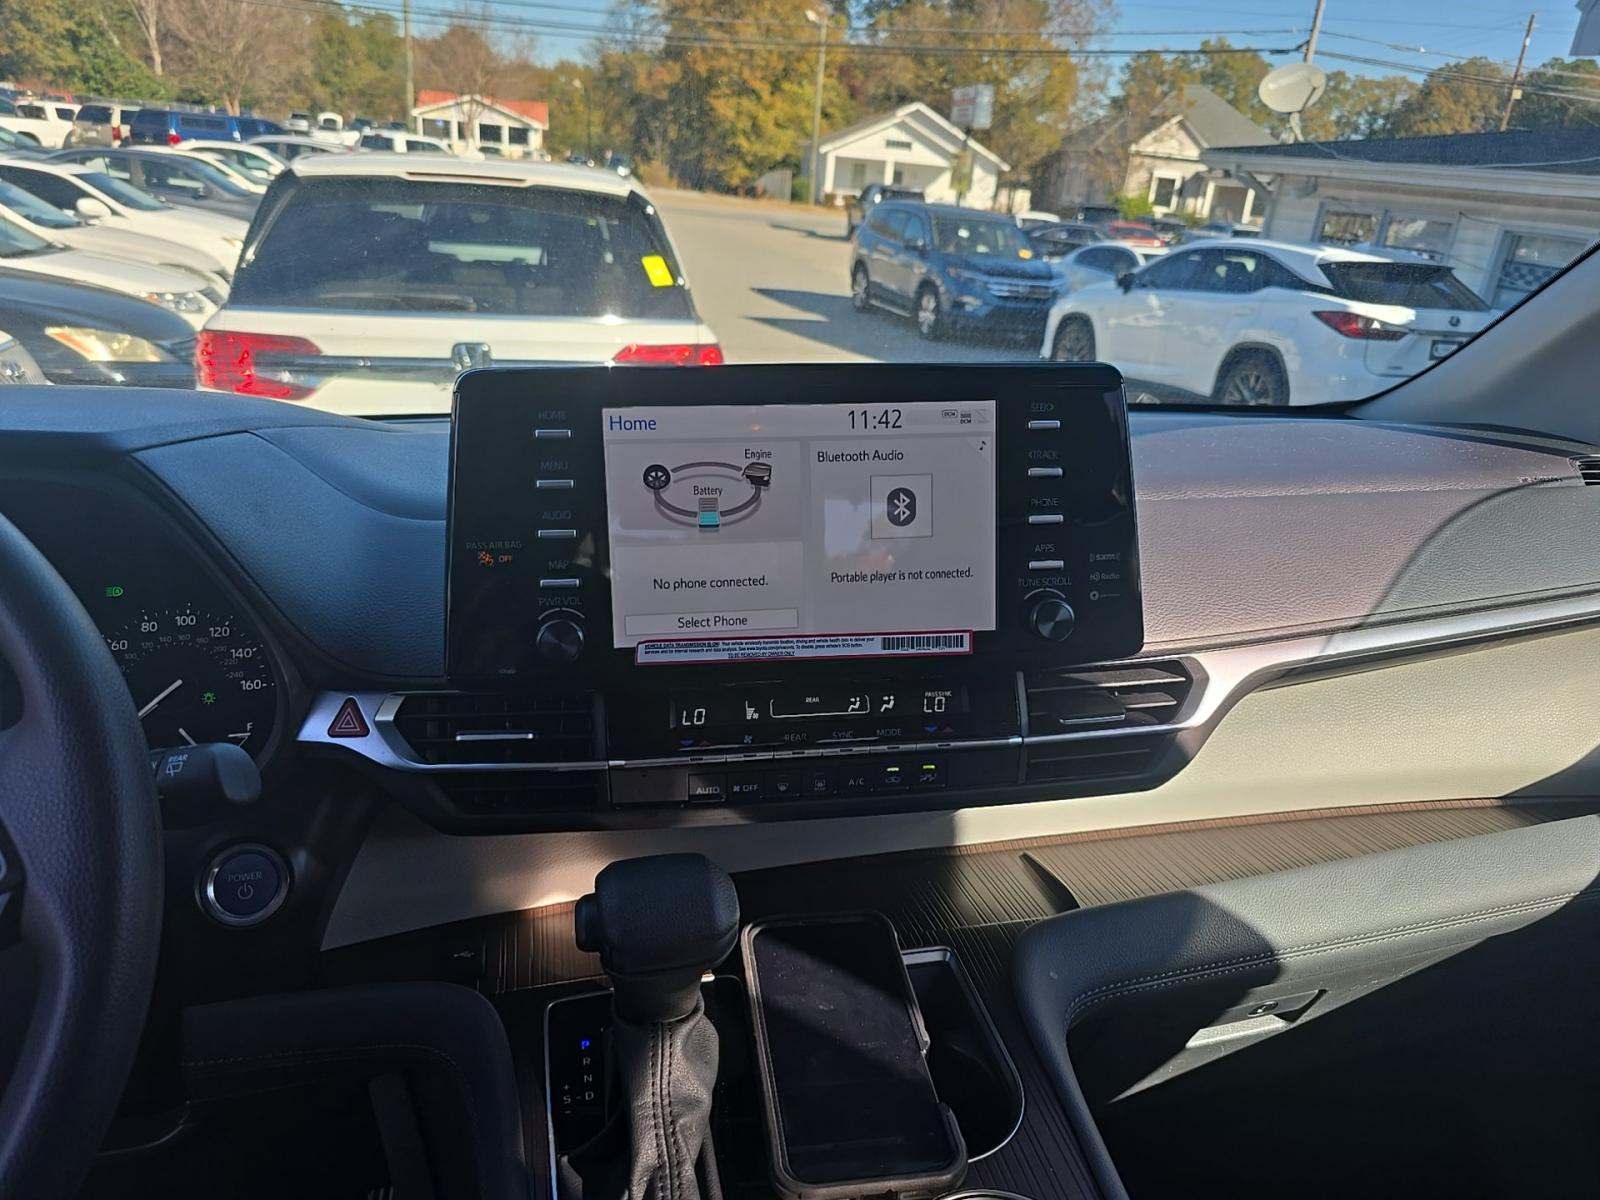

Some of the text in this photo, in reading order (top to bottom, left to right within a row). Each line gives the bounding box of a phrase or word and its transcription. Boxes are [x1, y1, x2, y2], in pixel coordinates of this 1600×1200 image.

[538, 410, 567, 420] HOME
[849, 409, 903, 430] 11:42
[609, 415, 657, 431] Home
[744, 449, 773, 460] Engine
[817, 449, 904, 463] Bluetooth Audio
[541, 460, 569, 472] MENU
[693, 485, 723, 497] Battery
[1031, 498, 1061, 506] PHONE
[542, 510, 572, 520] AUDIO
[1034, 543, 1055, 552] APPS
[498, 555, 512, 563] OFF
[548, 560, 569, 569] MAP
[831, 567, 974, 584] Portable player is not connected.
[653, 575, 769, 591] No phone connected.
[175, 615, 197, 626] 100
[677, 614, 748, 629] Select Phone
[141, 621, 158, 632] 80
[209, 626, 230, 638] 120
[111, 639, 128, 650] 60
[230, 647, 253, 659] 140
[240, 679, 262, 691] 160
[923, 697, 945, 712] LO
[682, 708, 706, 726] LO
[246, 722, 253, 732] F
[784, 733, 808, 742] REAR
[833, 730, 854, 738] SYNC
[849, 777, 865, 785] A/C
[696, 785, 720, 795] AUTO
[742, 784, 759, 792] OFF
[226, 871, 264, 882] POWER
[581, 1040, 590, 1050] P
[583, 1056, 591, 1066] R
[584, 1074, 592, 1083] N
[563, 1091, 594, 1104] S D
